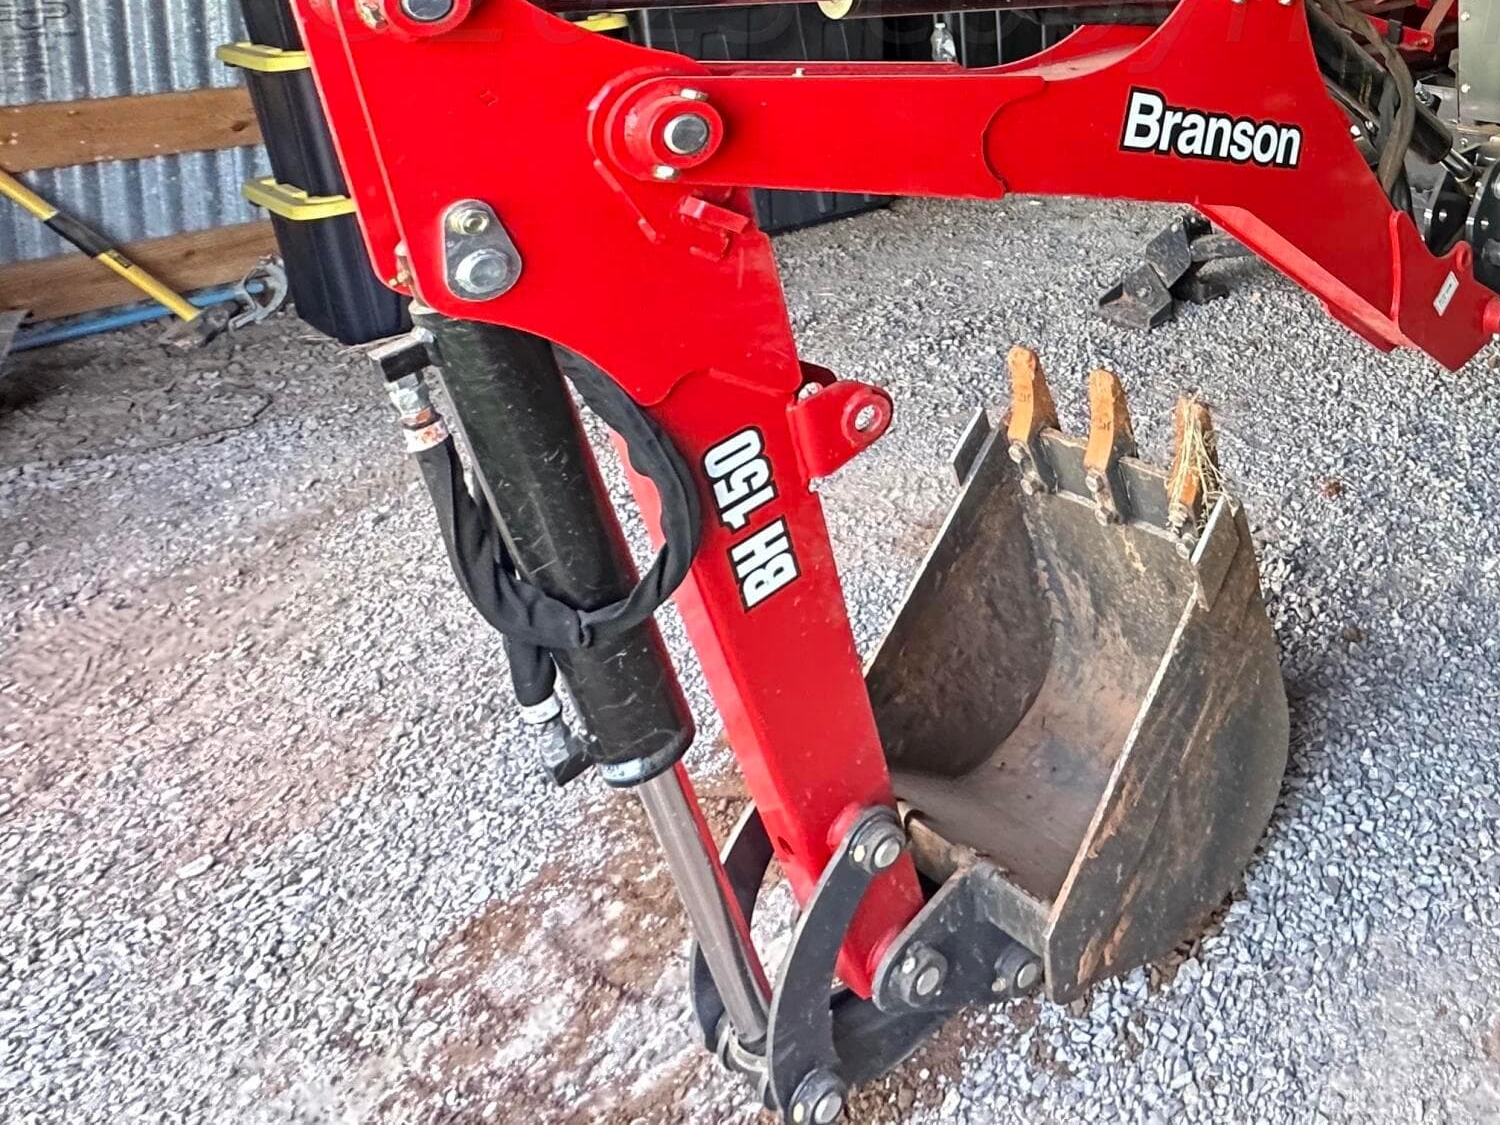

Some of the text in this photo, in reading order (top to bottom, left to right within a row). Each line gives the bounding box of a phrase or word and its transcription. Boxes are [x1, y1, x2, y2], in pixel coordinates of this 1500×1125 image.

[1121, 89, 1302, 166] Branson
[703, 428, 798, 608] BH 150
